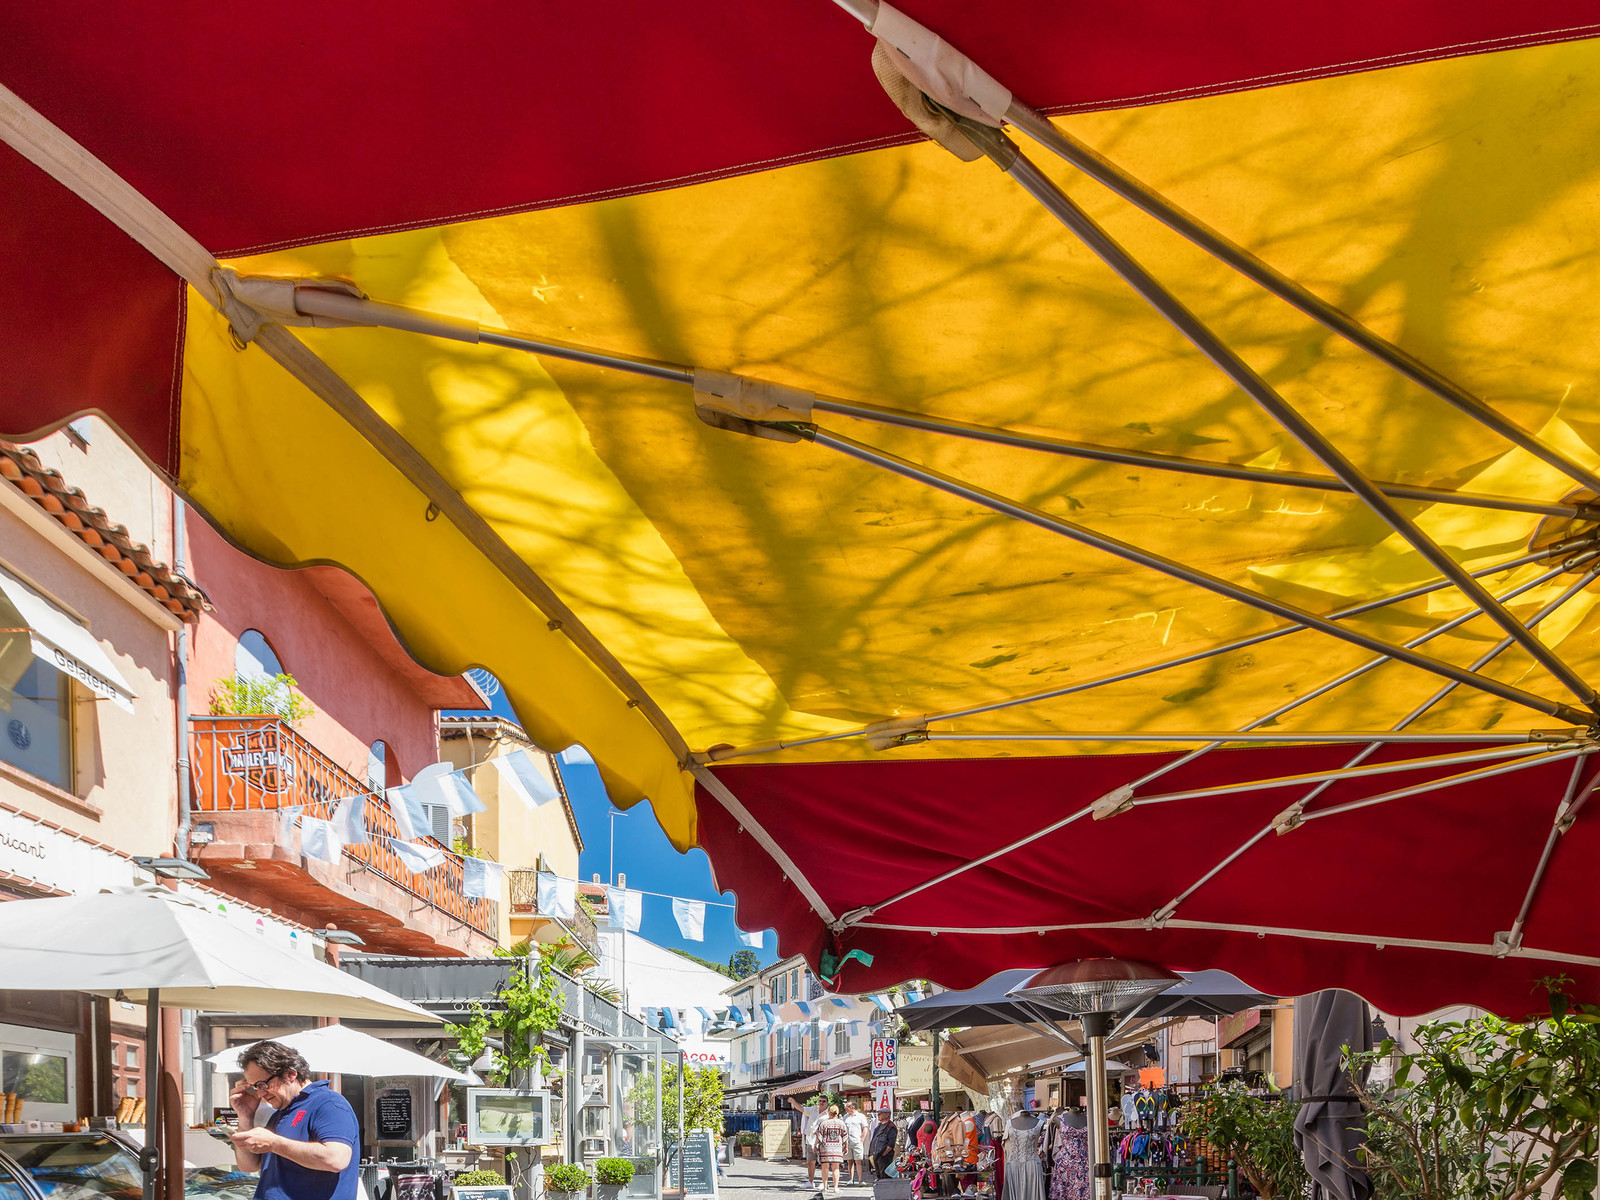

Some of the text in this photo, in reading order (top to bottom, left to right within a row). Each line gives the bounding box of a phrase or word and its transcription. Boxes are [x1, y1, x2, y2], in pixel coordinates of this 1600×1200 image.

[54, 647, 117, 699] Gelateria
[873, 1039, 884, 1069] TABAC
[885, 1039, 896, 1068] LOTO
